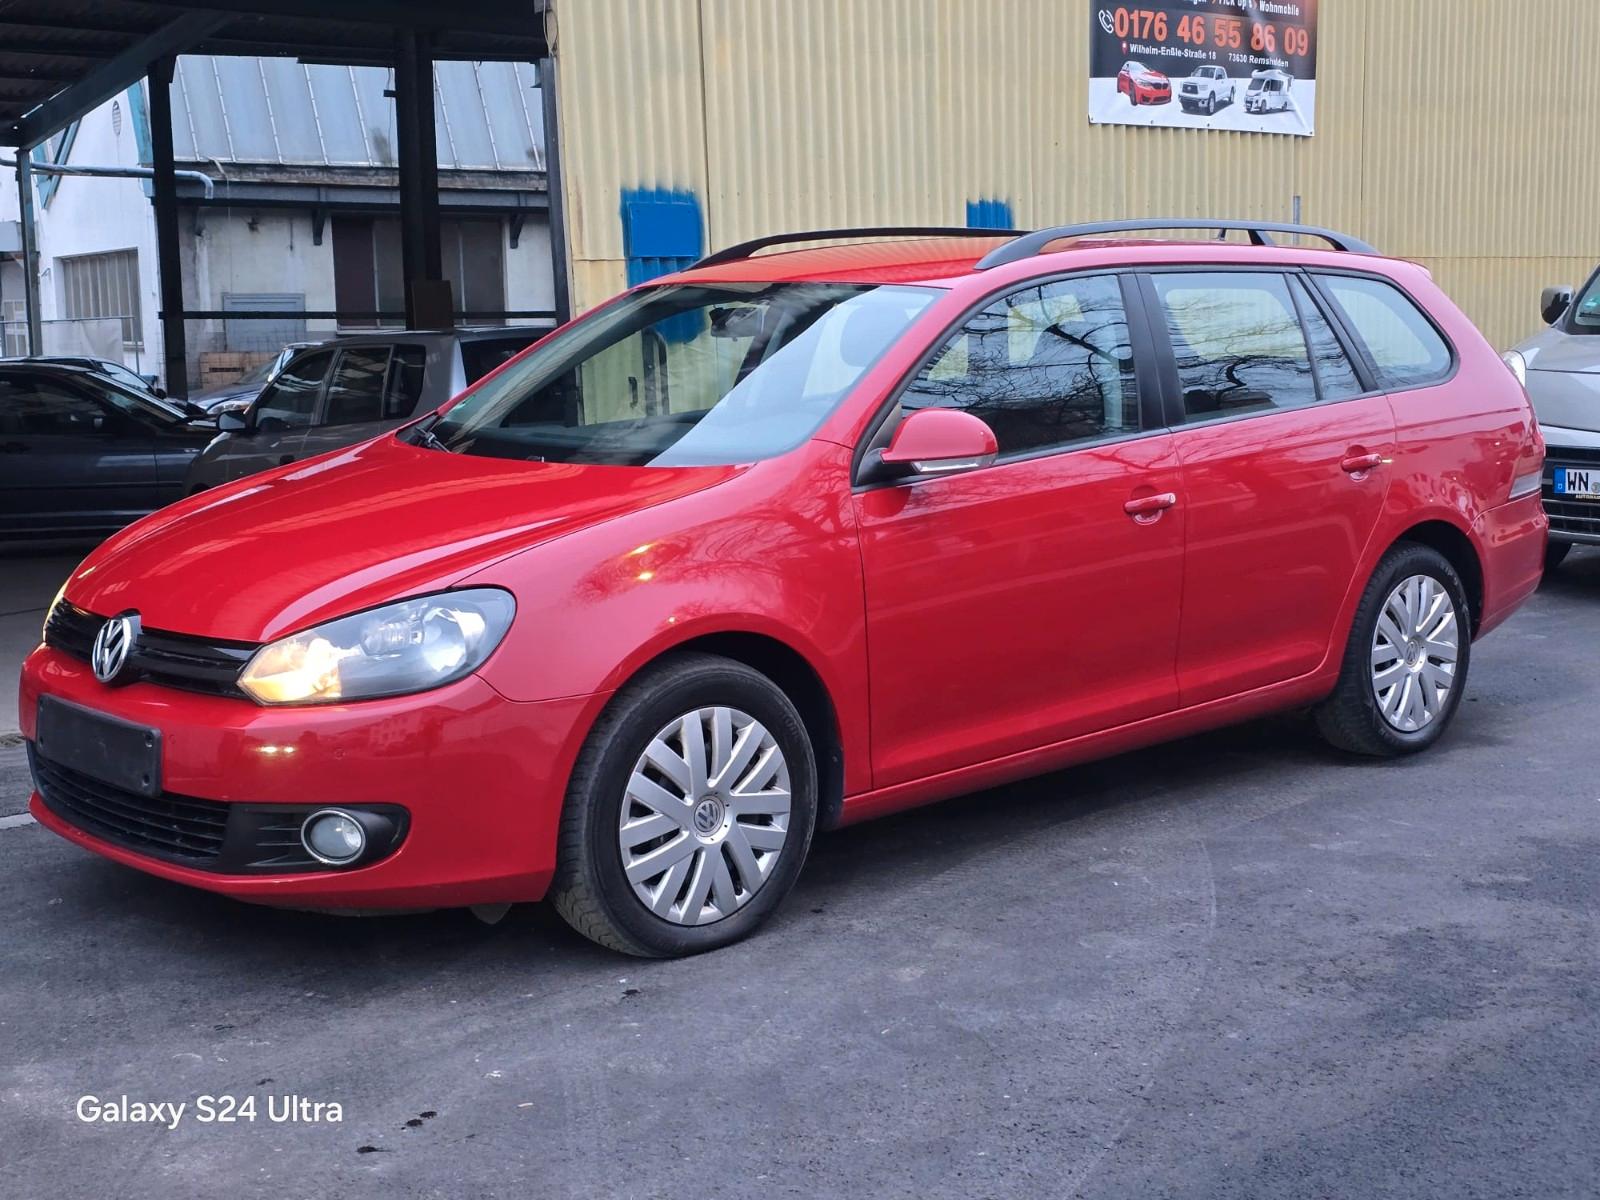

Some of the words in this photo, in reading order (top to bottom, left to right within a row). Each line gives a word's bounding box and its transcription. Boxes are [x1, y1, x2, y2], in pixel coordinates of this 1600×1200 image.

[1259, 0, 1300, 16] Wohnmobile
[1114, 7, 1168, 42] 0176
[1177, 15, 1205, 45] 46
[1214, 18, 1241, 48] 55
[1251, 22, 1276, 53] 86
[1284, 26, 1309, 56] 09
[1208, 51, 1217, 60] 18
[1228, 52, 1248, 63] 73630
[1567, 471, 1589, 491] WN
